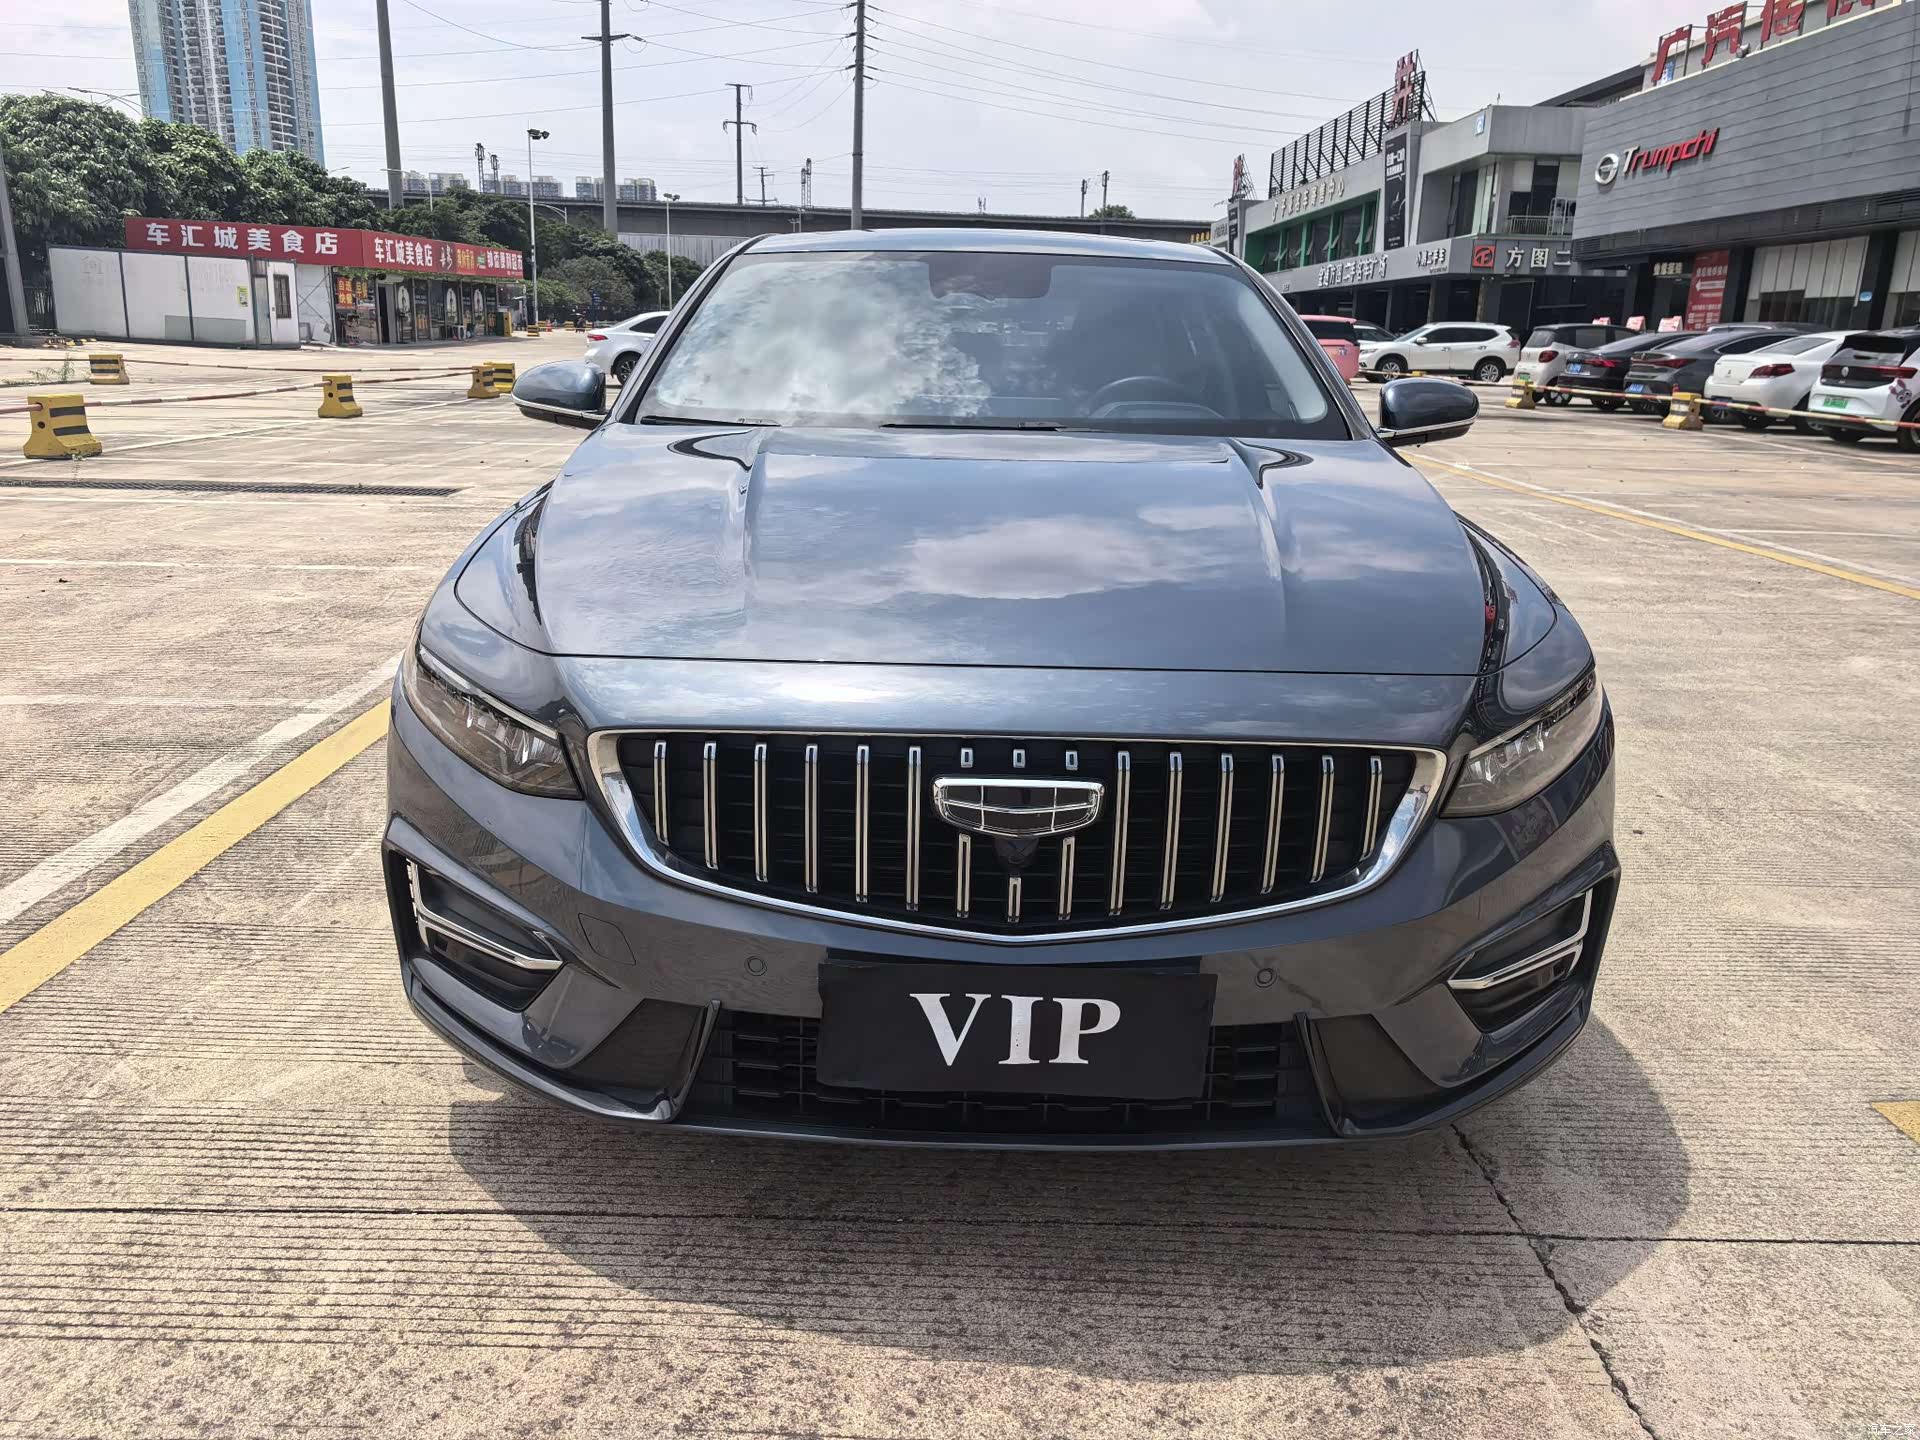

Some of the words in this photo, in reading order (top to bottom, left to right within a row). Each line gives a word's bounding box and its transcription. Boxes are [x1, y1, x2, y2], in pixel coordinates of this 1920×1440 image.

[1622, 128, 1719, 173] Trumpchi
[146, 222, 338, 255] 车汇城美食店
[374, 236, 433, 267] 车汇城美食店
[1506, 247, 1571, 268] 方图二
[909, 993, 1121, 1067] VIP
